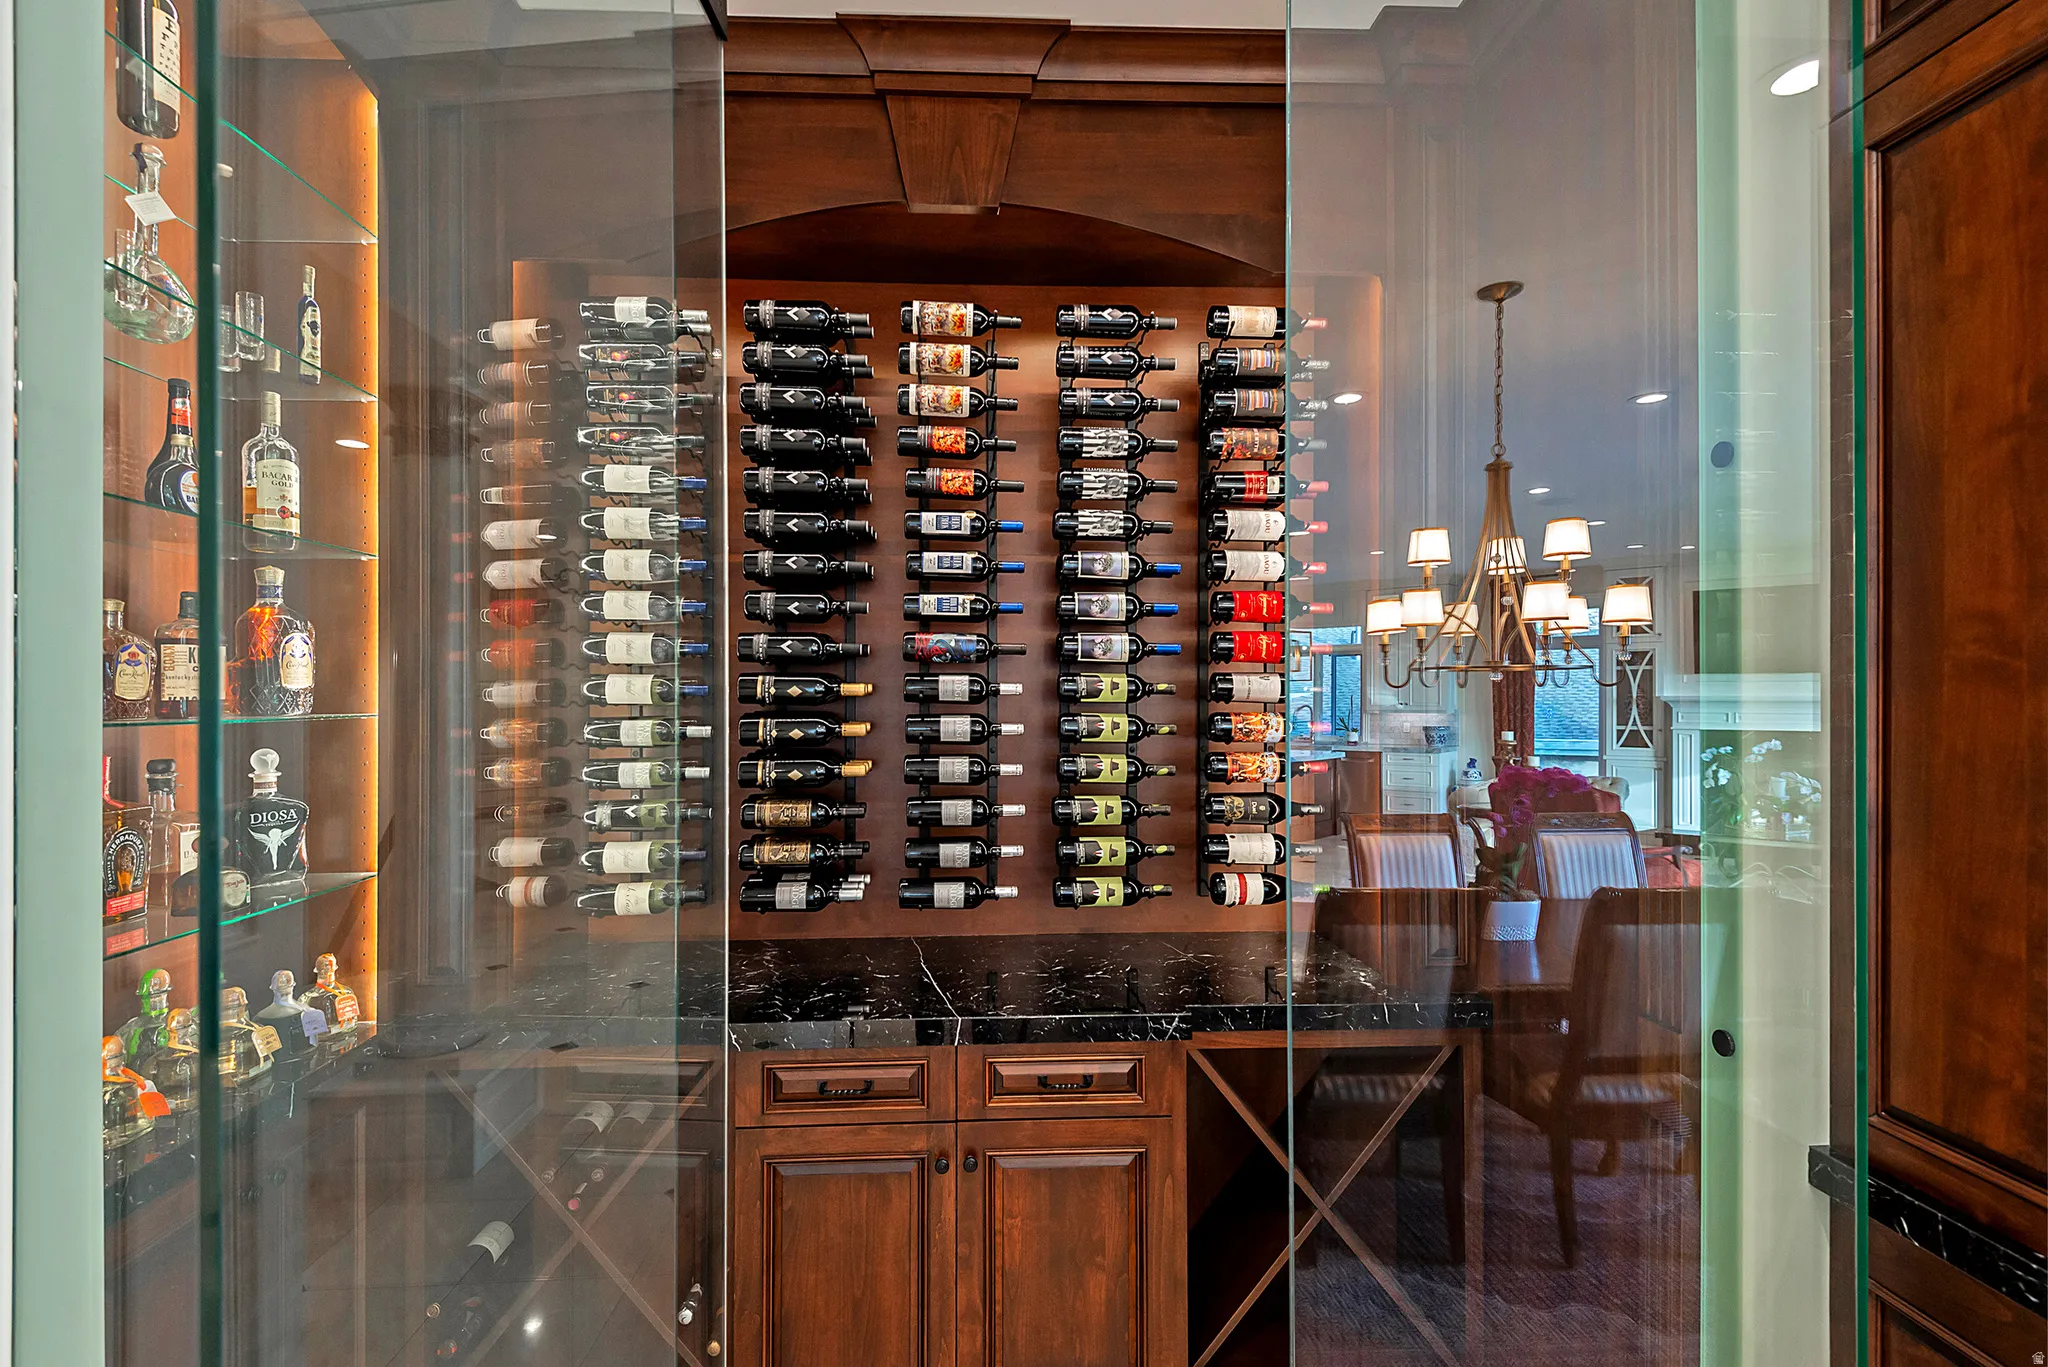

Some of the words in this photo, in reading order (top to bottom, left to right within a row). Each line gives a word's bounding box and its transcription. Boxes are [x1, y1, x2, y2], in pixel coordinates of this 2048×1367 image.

[261, 471, 293, 483] BACAR
[250, 808, 298, 825] DIOSA
[108, 834, 144, 855] HERRADURA
